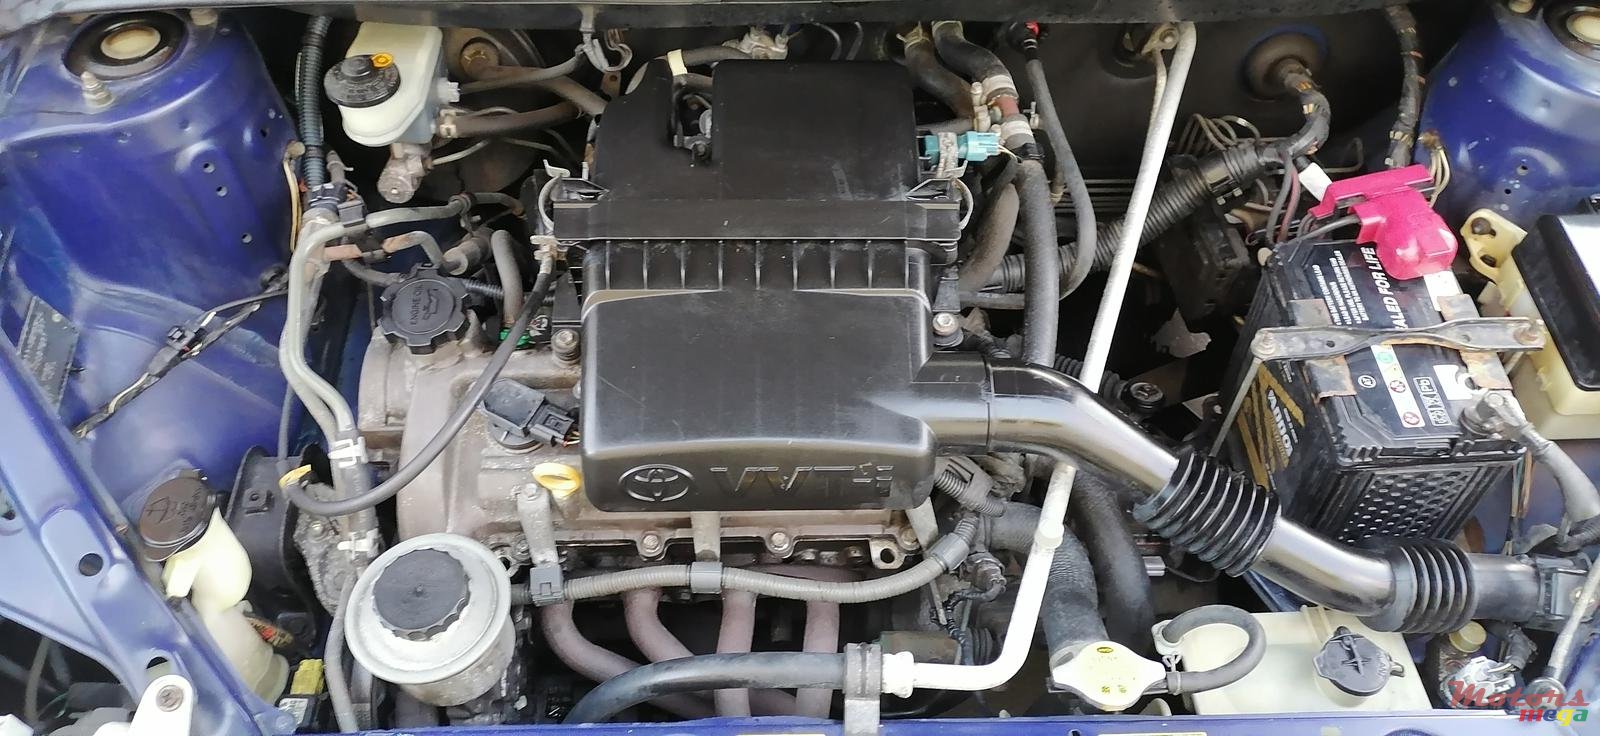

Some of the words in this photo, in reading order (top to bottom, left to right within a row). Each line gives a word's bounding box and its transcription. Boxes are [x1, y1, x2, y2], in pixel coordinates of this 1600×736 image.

[1360, 246, 1382, 270] LIFE
[1371, 271, 1394, 295] FOR
[1420, 379, 1434, 392] Pb
